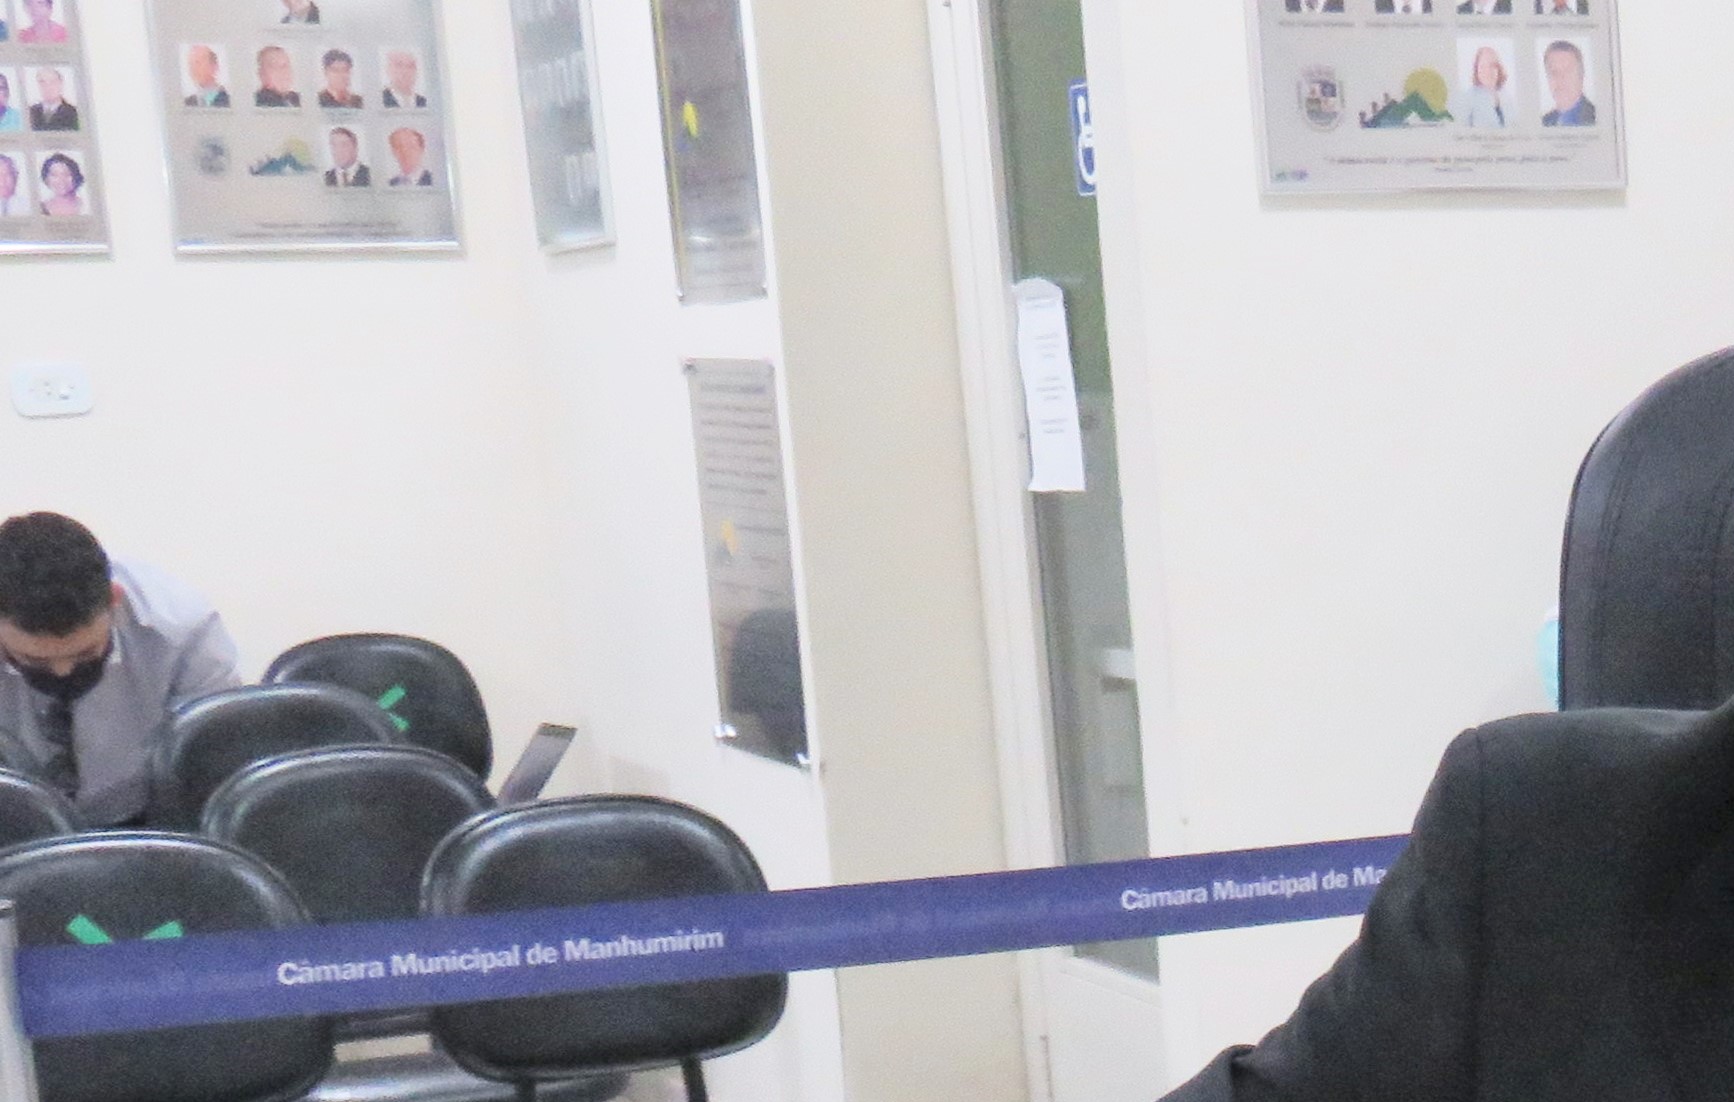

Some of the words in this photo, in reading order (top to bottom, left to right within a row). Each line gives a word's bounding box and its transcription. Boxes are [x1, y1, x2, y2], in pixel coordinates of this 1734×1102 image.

[1120, 884, 1208, 911] Câmara
[1213, 871, 1317, 901] Municipal
[1321, 868, 1350, 891] de
[276, 957, 385, 987] Câmara
[390, 943, 521, 977] Municipal
[526, 941, 559, 966] de
[563, 926, 725, 963] Manhumirim
